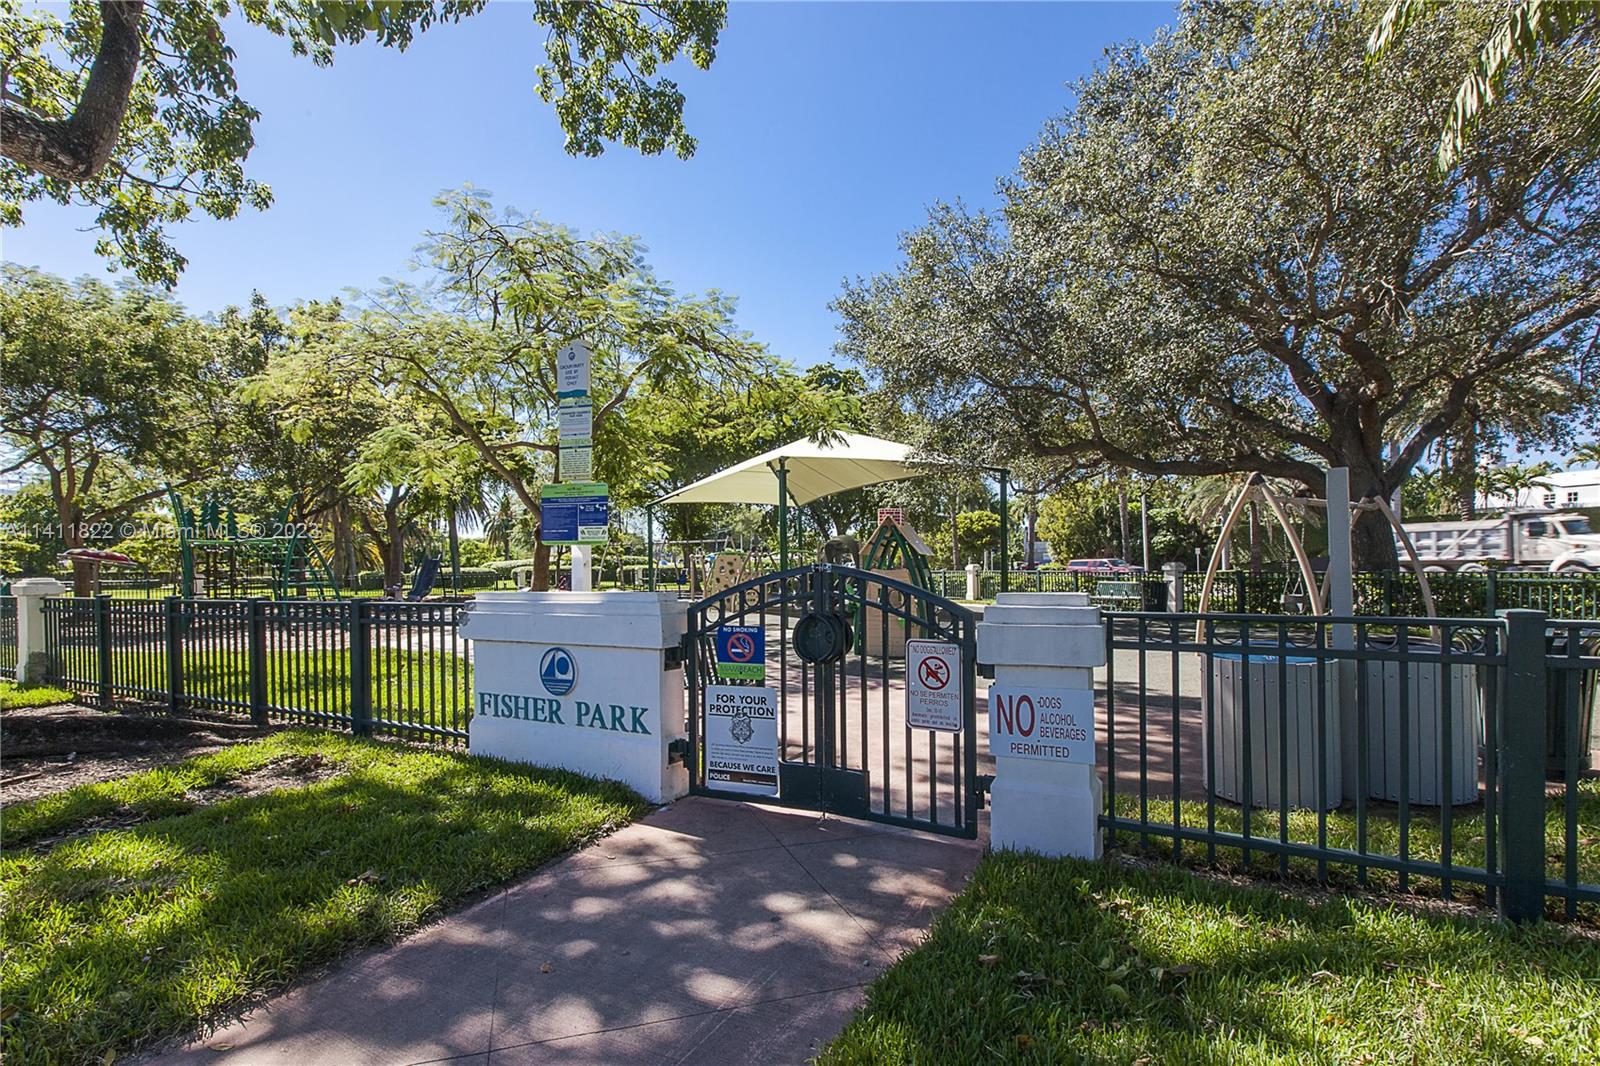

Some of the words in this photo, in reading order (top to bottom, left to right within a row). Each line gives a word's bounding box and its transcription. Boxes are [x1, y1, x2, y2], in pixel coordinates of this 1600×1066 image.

[716, 694, 736, 703] FOR
[739, 695, 767, 706] YOUR
[920, 698, 948, 707] PERROS
[478, 692, 565, 725] FISHER
[575, 701, 652, 735] PARK
[710, 704, 774, 716] PROTECTION
[996, 694, 1035, 737] NO
[1040, 713, 1076, 726] ALCOHOL
[1040, 726, 1086, 741] BEVERAGES
[1010, 742, 1070, 758] PERMITTED
[710, 761, 741, 770] BECAUSE
[743, 764, 754, 772] WE
[756, 765, 776, 773] CARE
[710, 772, 730, 780] POLICE
